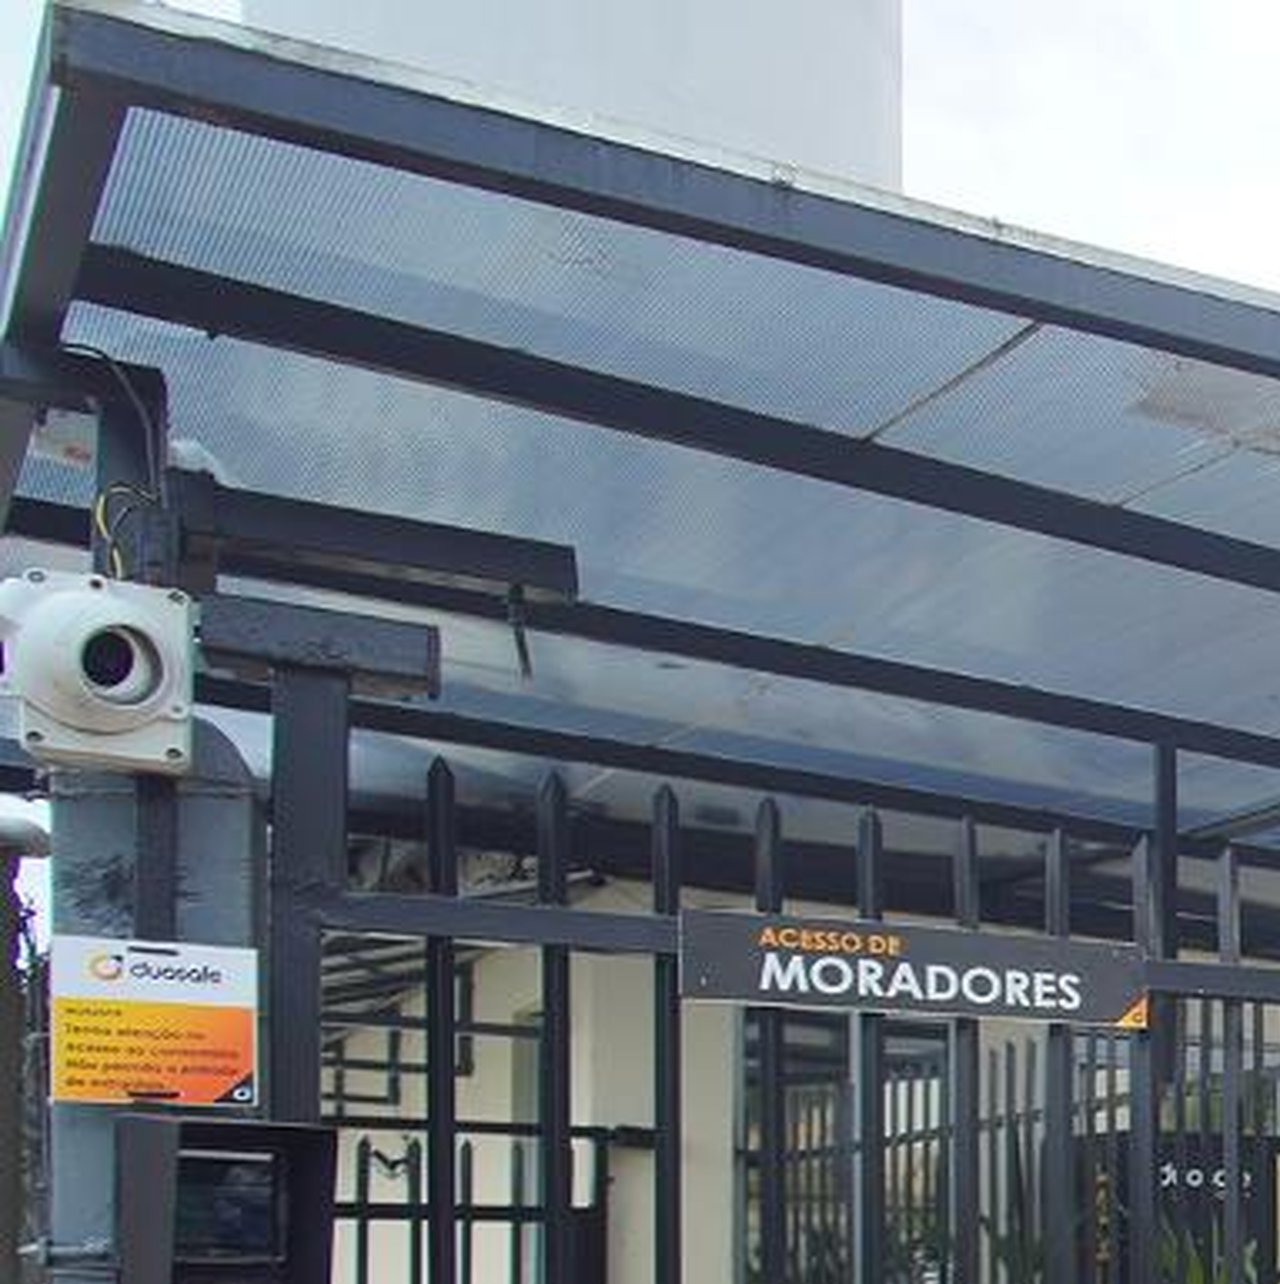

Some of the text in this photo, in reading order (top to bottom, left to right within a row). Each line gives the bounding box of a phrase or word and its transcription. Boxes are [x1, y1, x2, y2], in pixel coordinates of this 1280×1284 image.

[759, 927, 901, 955] ACESSO DE
[758, 953, 1082, 1010] MORADORES
